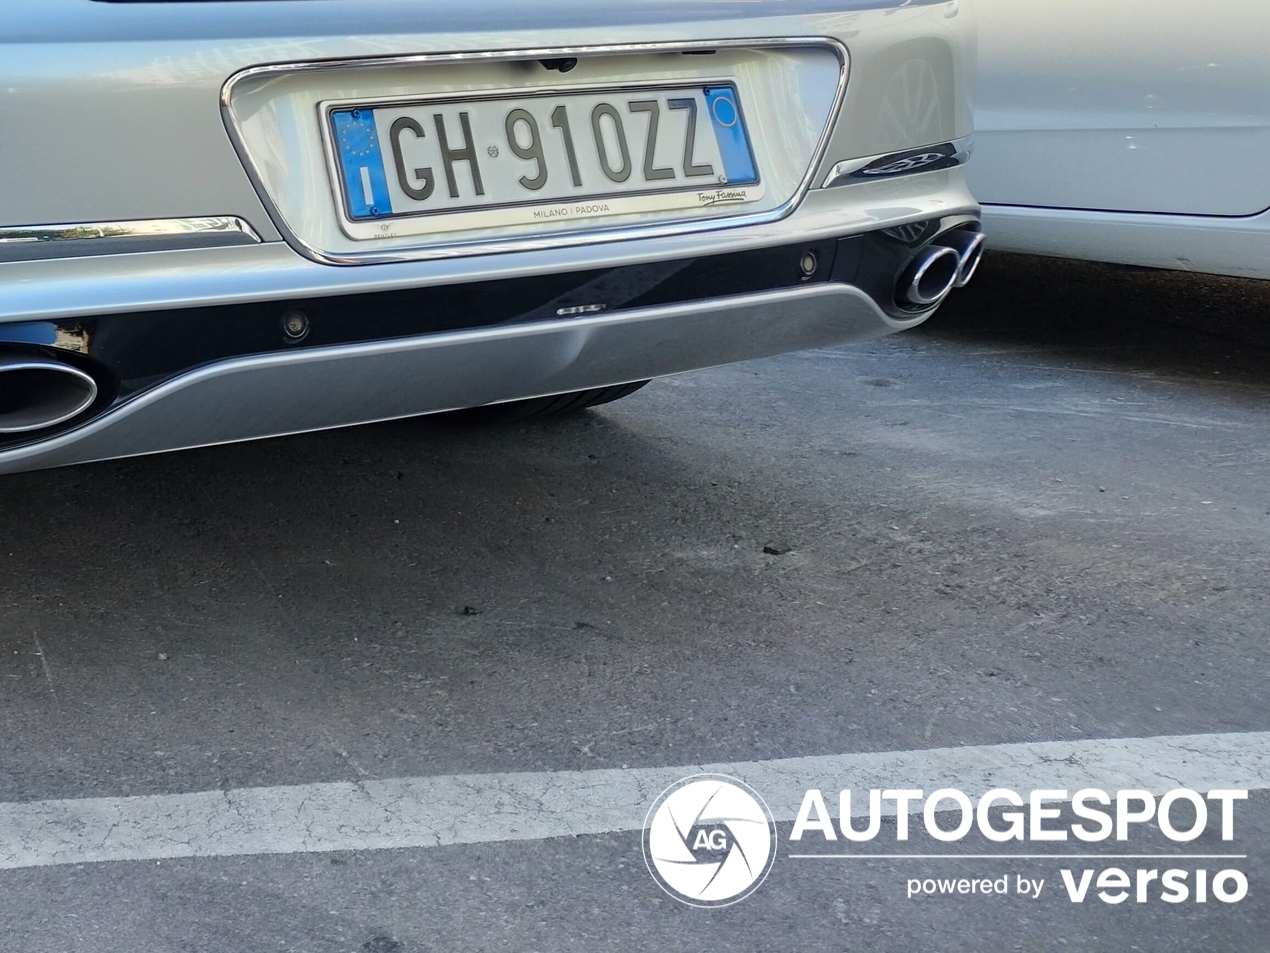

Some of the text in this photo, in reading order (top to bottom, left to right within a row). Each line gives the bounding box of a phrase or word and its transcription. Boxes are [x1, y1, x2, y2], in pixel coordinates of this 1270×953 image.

[389, 97, 715, 201] GH 910ZZ
[359, 166, 375, 205] I
[696, 192, 716, 205] Tony
[533, 208, 568, 218] MILANO
[575, 204, 610, 214] PADOVA
